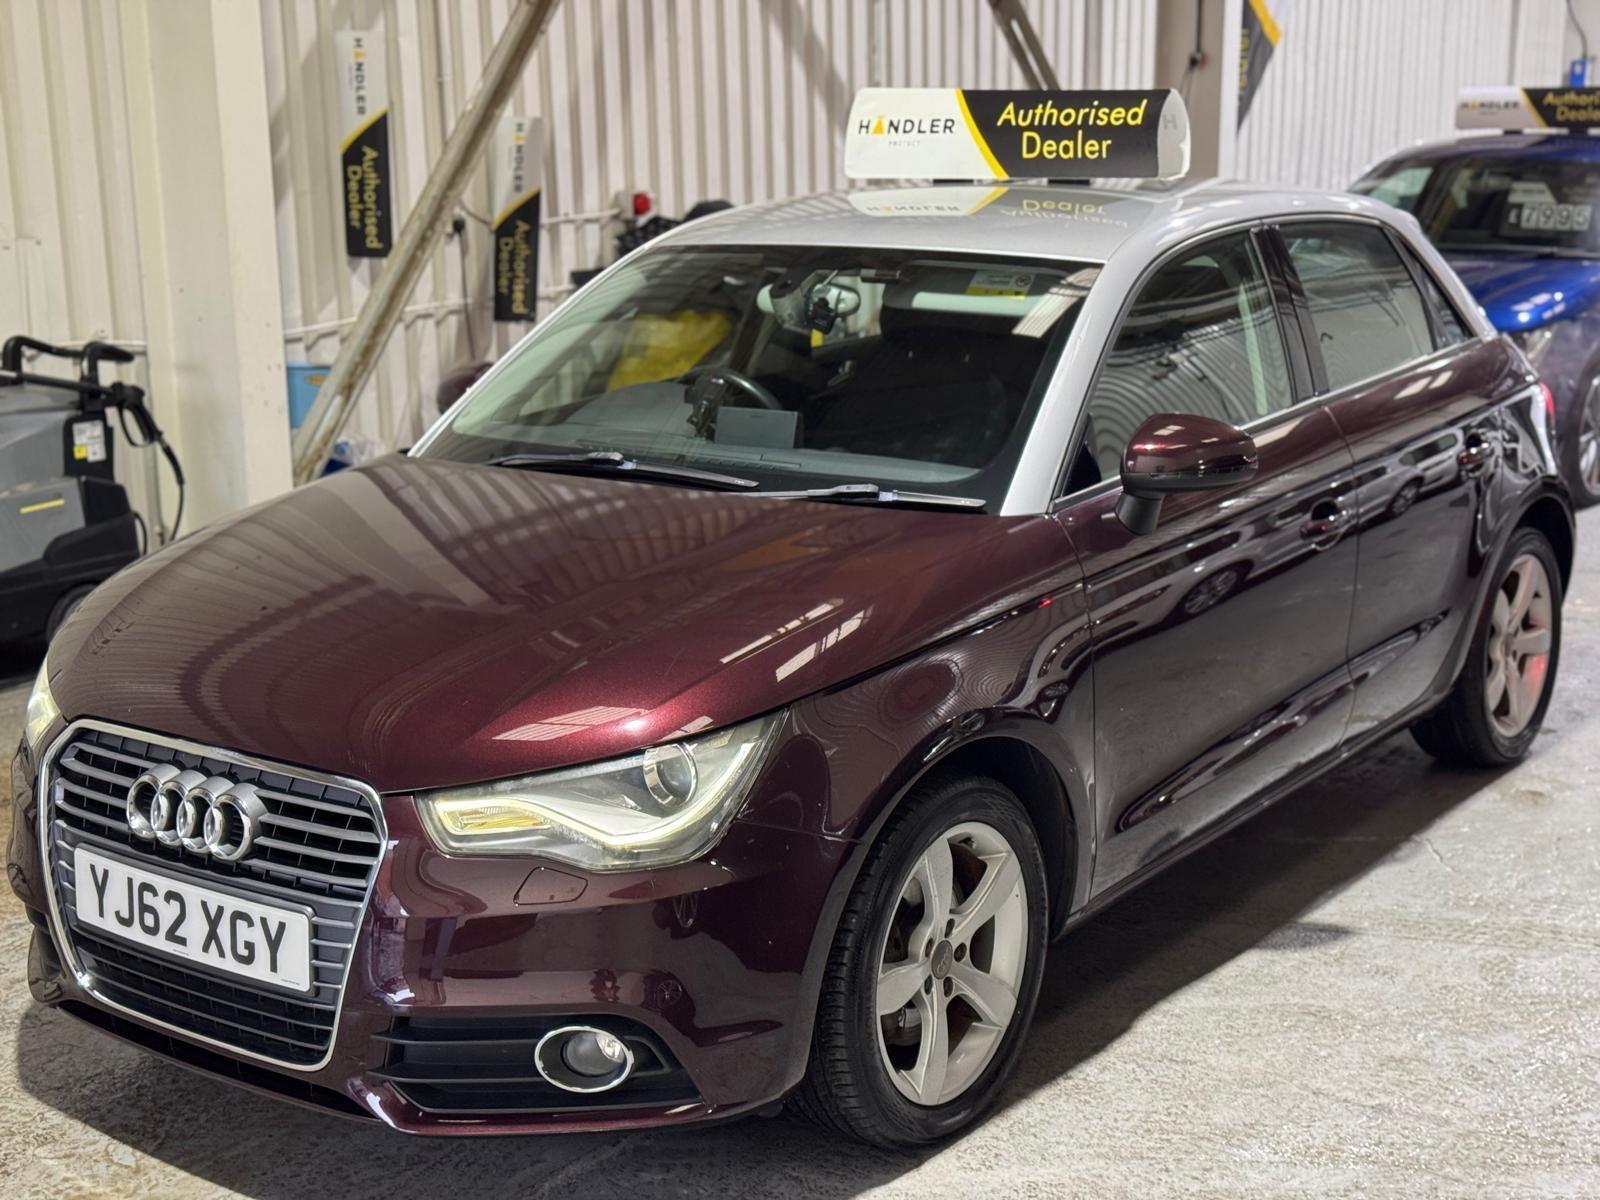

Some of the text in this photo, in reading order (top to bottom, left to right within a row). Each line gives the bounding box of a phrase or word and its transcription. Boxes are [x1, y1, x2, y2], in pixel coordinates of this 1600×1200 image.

[353, 37, 366, 115] HANDLER
[858, 114, 956, 135] HANDLER
[997, 99, 1148, 127] Authorised
[1022, 129, 1112, 159] Dealer
[347, 164, 364, 229] Dealer
[361, 145, 384, 249] Authorised
[512, 219, 532, 315] Authorised
[90, 863, 287, 974] YJ62 XGY
